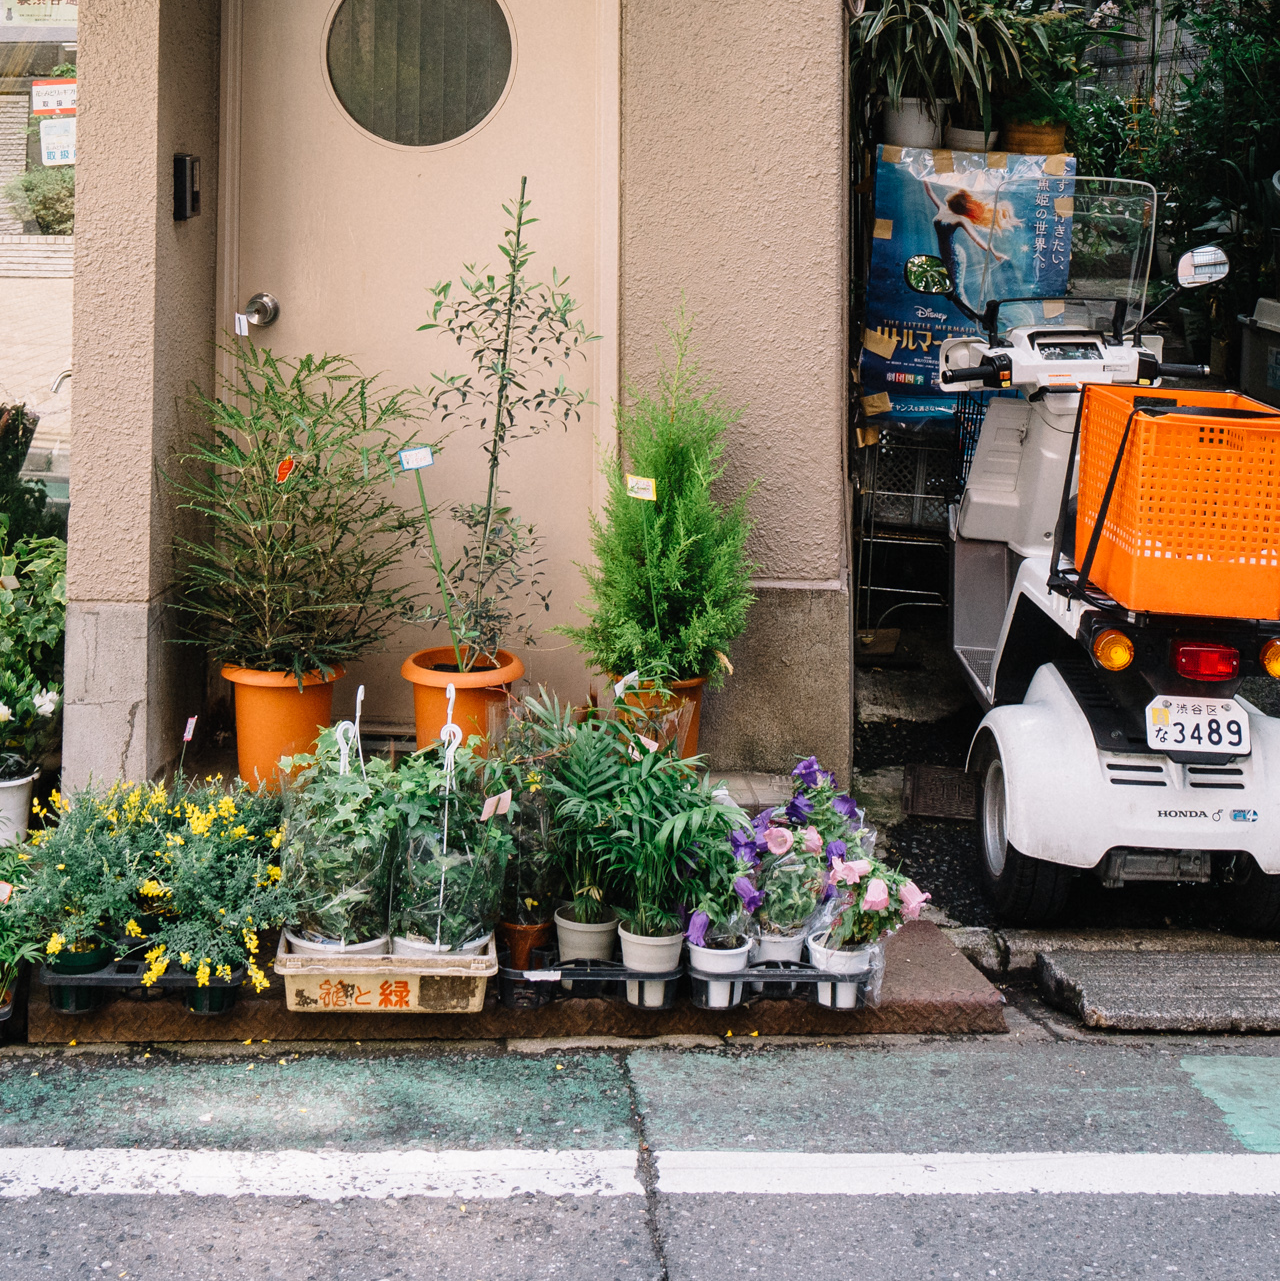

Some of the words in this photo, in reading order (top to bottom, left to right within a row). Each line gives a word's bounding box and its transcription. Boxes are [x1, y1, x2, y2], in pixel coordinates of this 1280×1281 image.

[47, 149, 76, 160] 取扱
[1033, 164, 1051, 269] 魚姫の世界へ。
[1052, 164, 1071, 270] す行きたい、
[903, 321, 932, 329] LITTLE
[935, 324, 976, 333] MERMAID
[886, 372, 925, 385] 劇団四季
[1176, 704, 1218, 716] 渋谷区
[1155, 727, 1168, 743] な
[1173, 718, 1243, 747] 3489
[1157, 810, 1208, 818] HONDA
